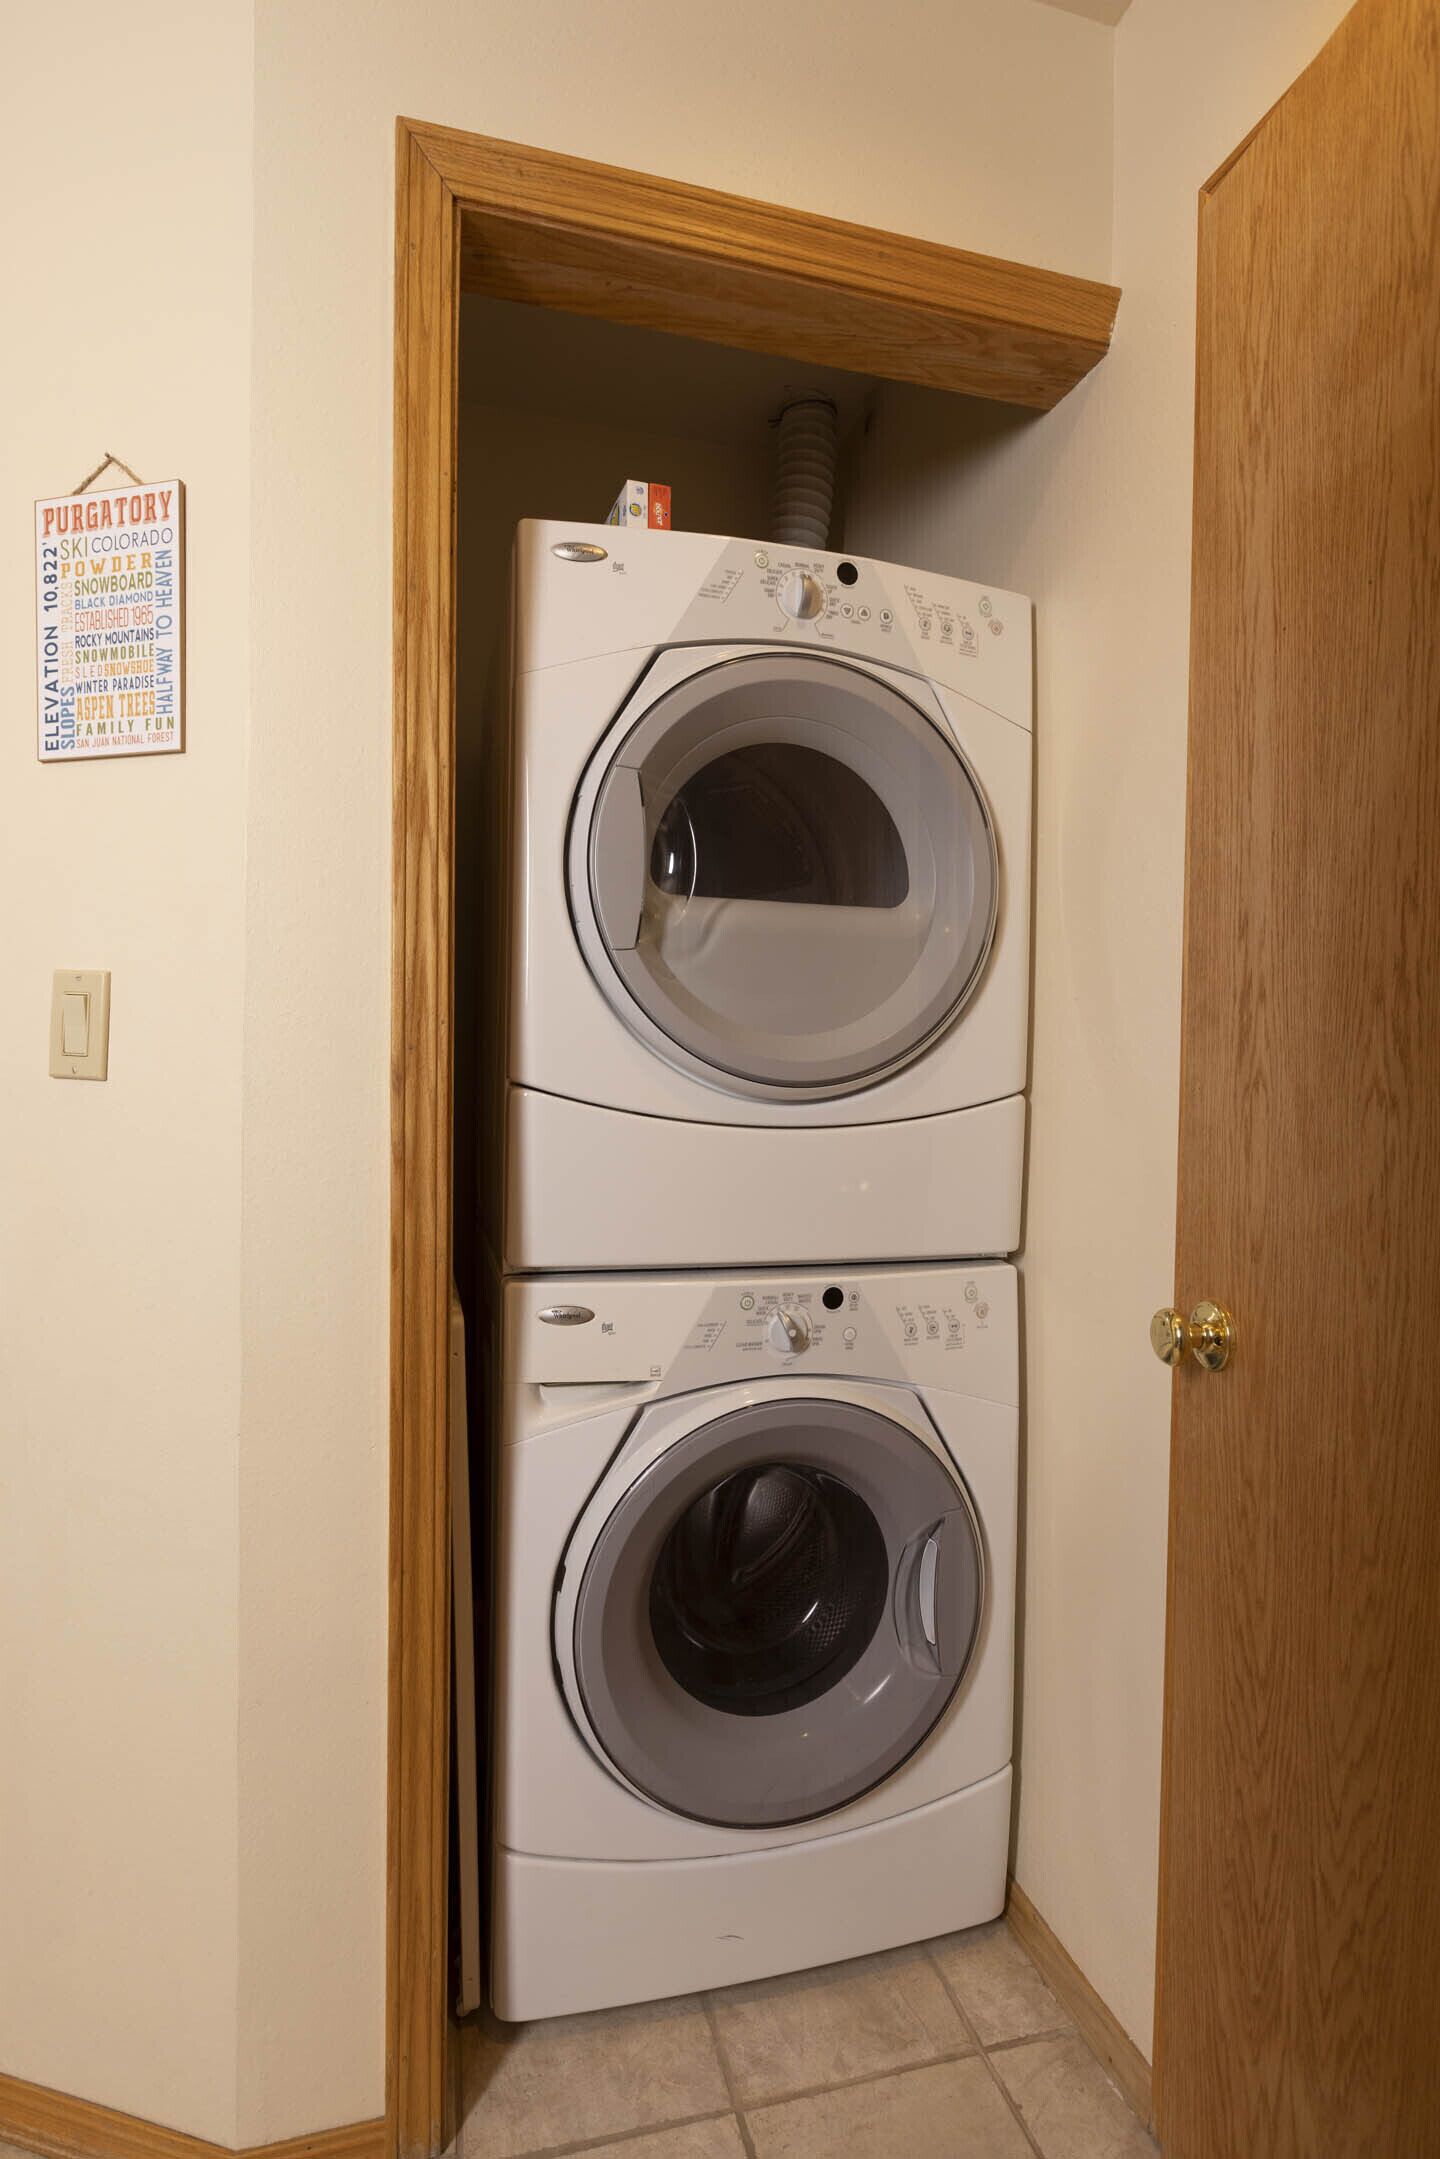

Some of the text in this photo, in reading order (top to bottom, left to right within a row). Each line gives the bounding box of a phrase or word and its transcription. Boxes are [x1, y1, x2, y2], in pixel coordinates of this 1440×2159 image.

[43, 490, 172, 538] PURGATORY
[60, 528, 173, 560] SKI COLORADO
[60, 552, 152, 579] POWDER
[74, 571, 153, 597] SNOWBOARD
[75, 591, 154, 611] BLACK DIAMOND
[75, 604, 154, 632] ESTABLISHED 1965
[75, 628, 155, 648] ROCKY MOUNTAINS
[155, 549, 173, 715] HALFWAY TO HEAVEN
[75, 643, 154, 665] SNOWMOBILE
[75, 659, 154, 679] SLED SNOWSHOE
[44, 626, 59, 751] ELEVATION
[76, 675, 155, 694] WINTER PARADISE
[60, 686, 75, 749] SLOPES
[76, 690, 156, 721] ASPEN TREES
[76, 717, 175, 737] FAMILY FUN
[76, 731, 174, 749] SAN JUAN NATIONAL FOREST
